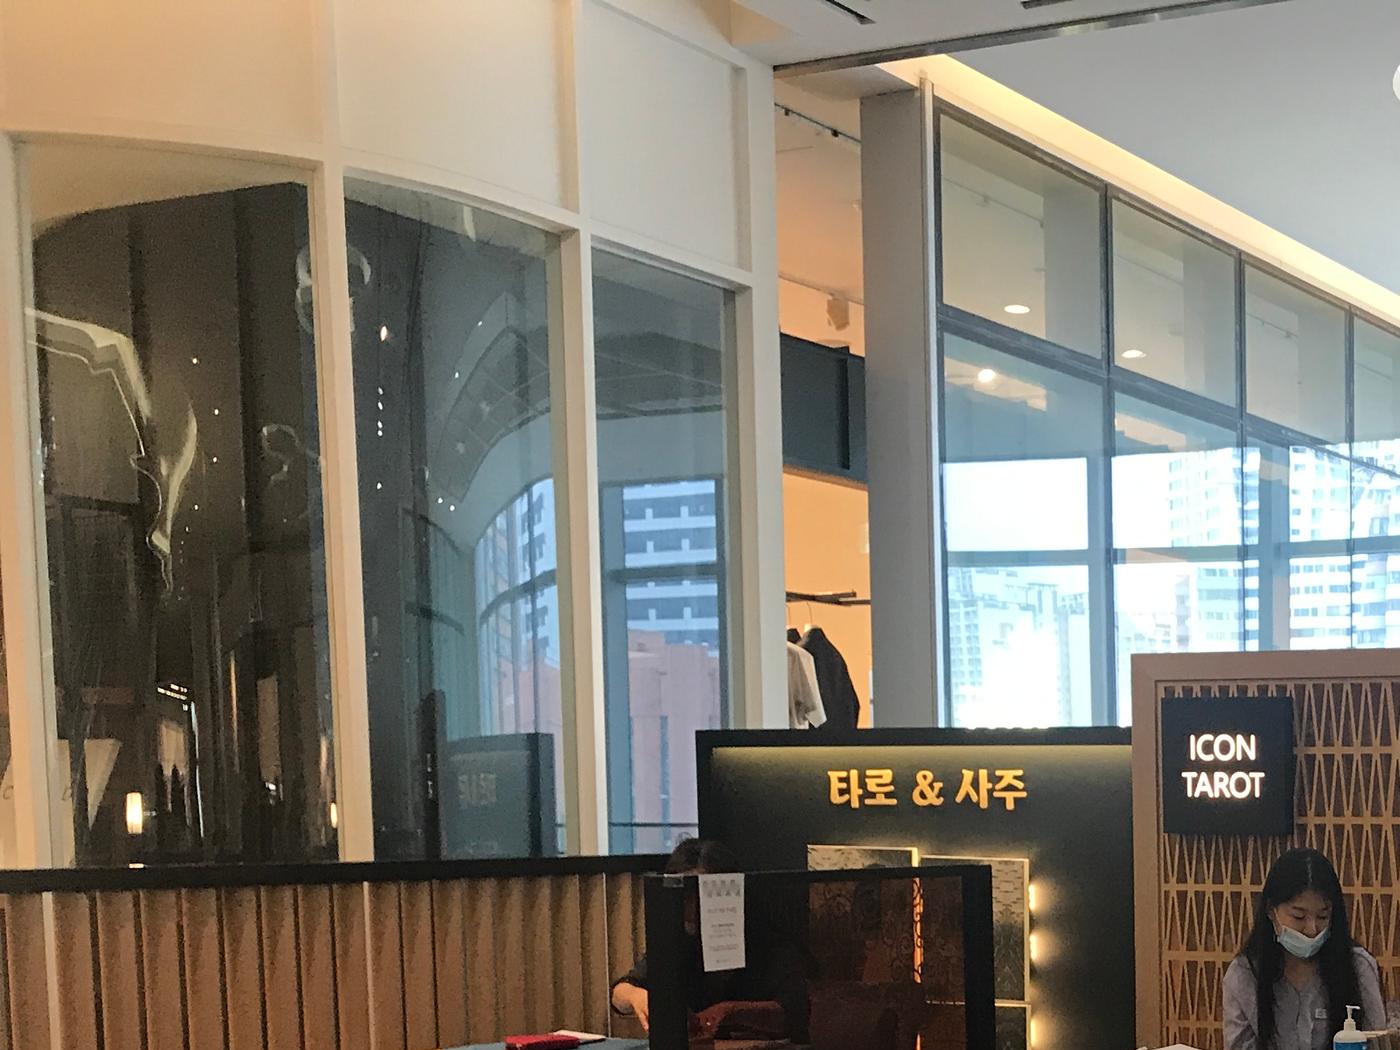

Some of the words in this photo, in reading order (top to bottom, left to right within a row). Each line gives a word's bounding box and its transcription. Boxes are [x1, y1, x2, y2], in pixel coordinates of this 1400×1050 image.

[1189, 733, 1256, 762] ICON
[827, 768, 898, 809] 타로
[912, 769, 945, 807] &
[955, 768, 1028, 811] 사주
[1181, 771, 1266, 799] TAROT
